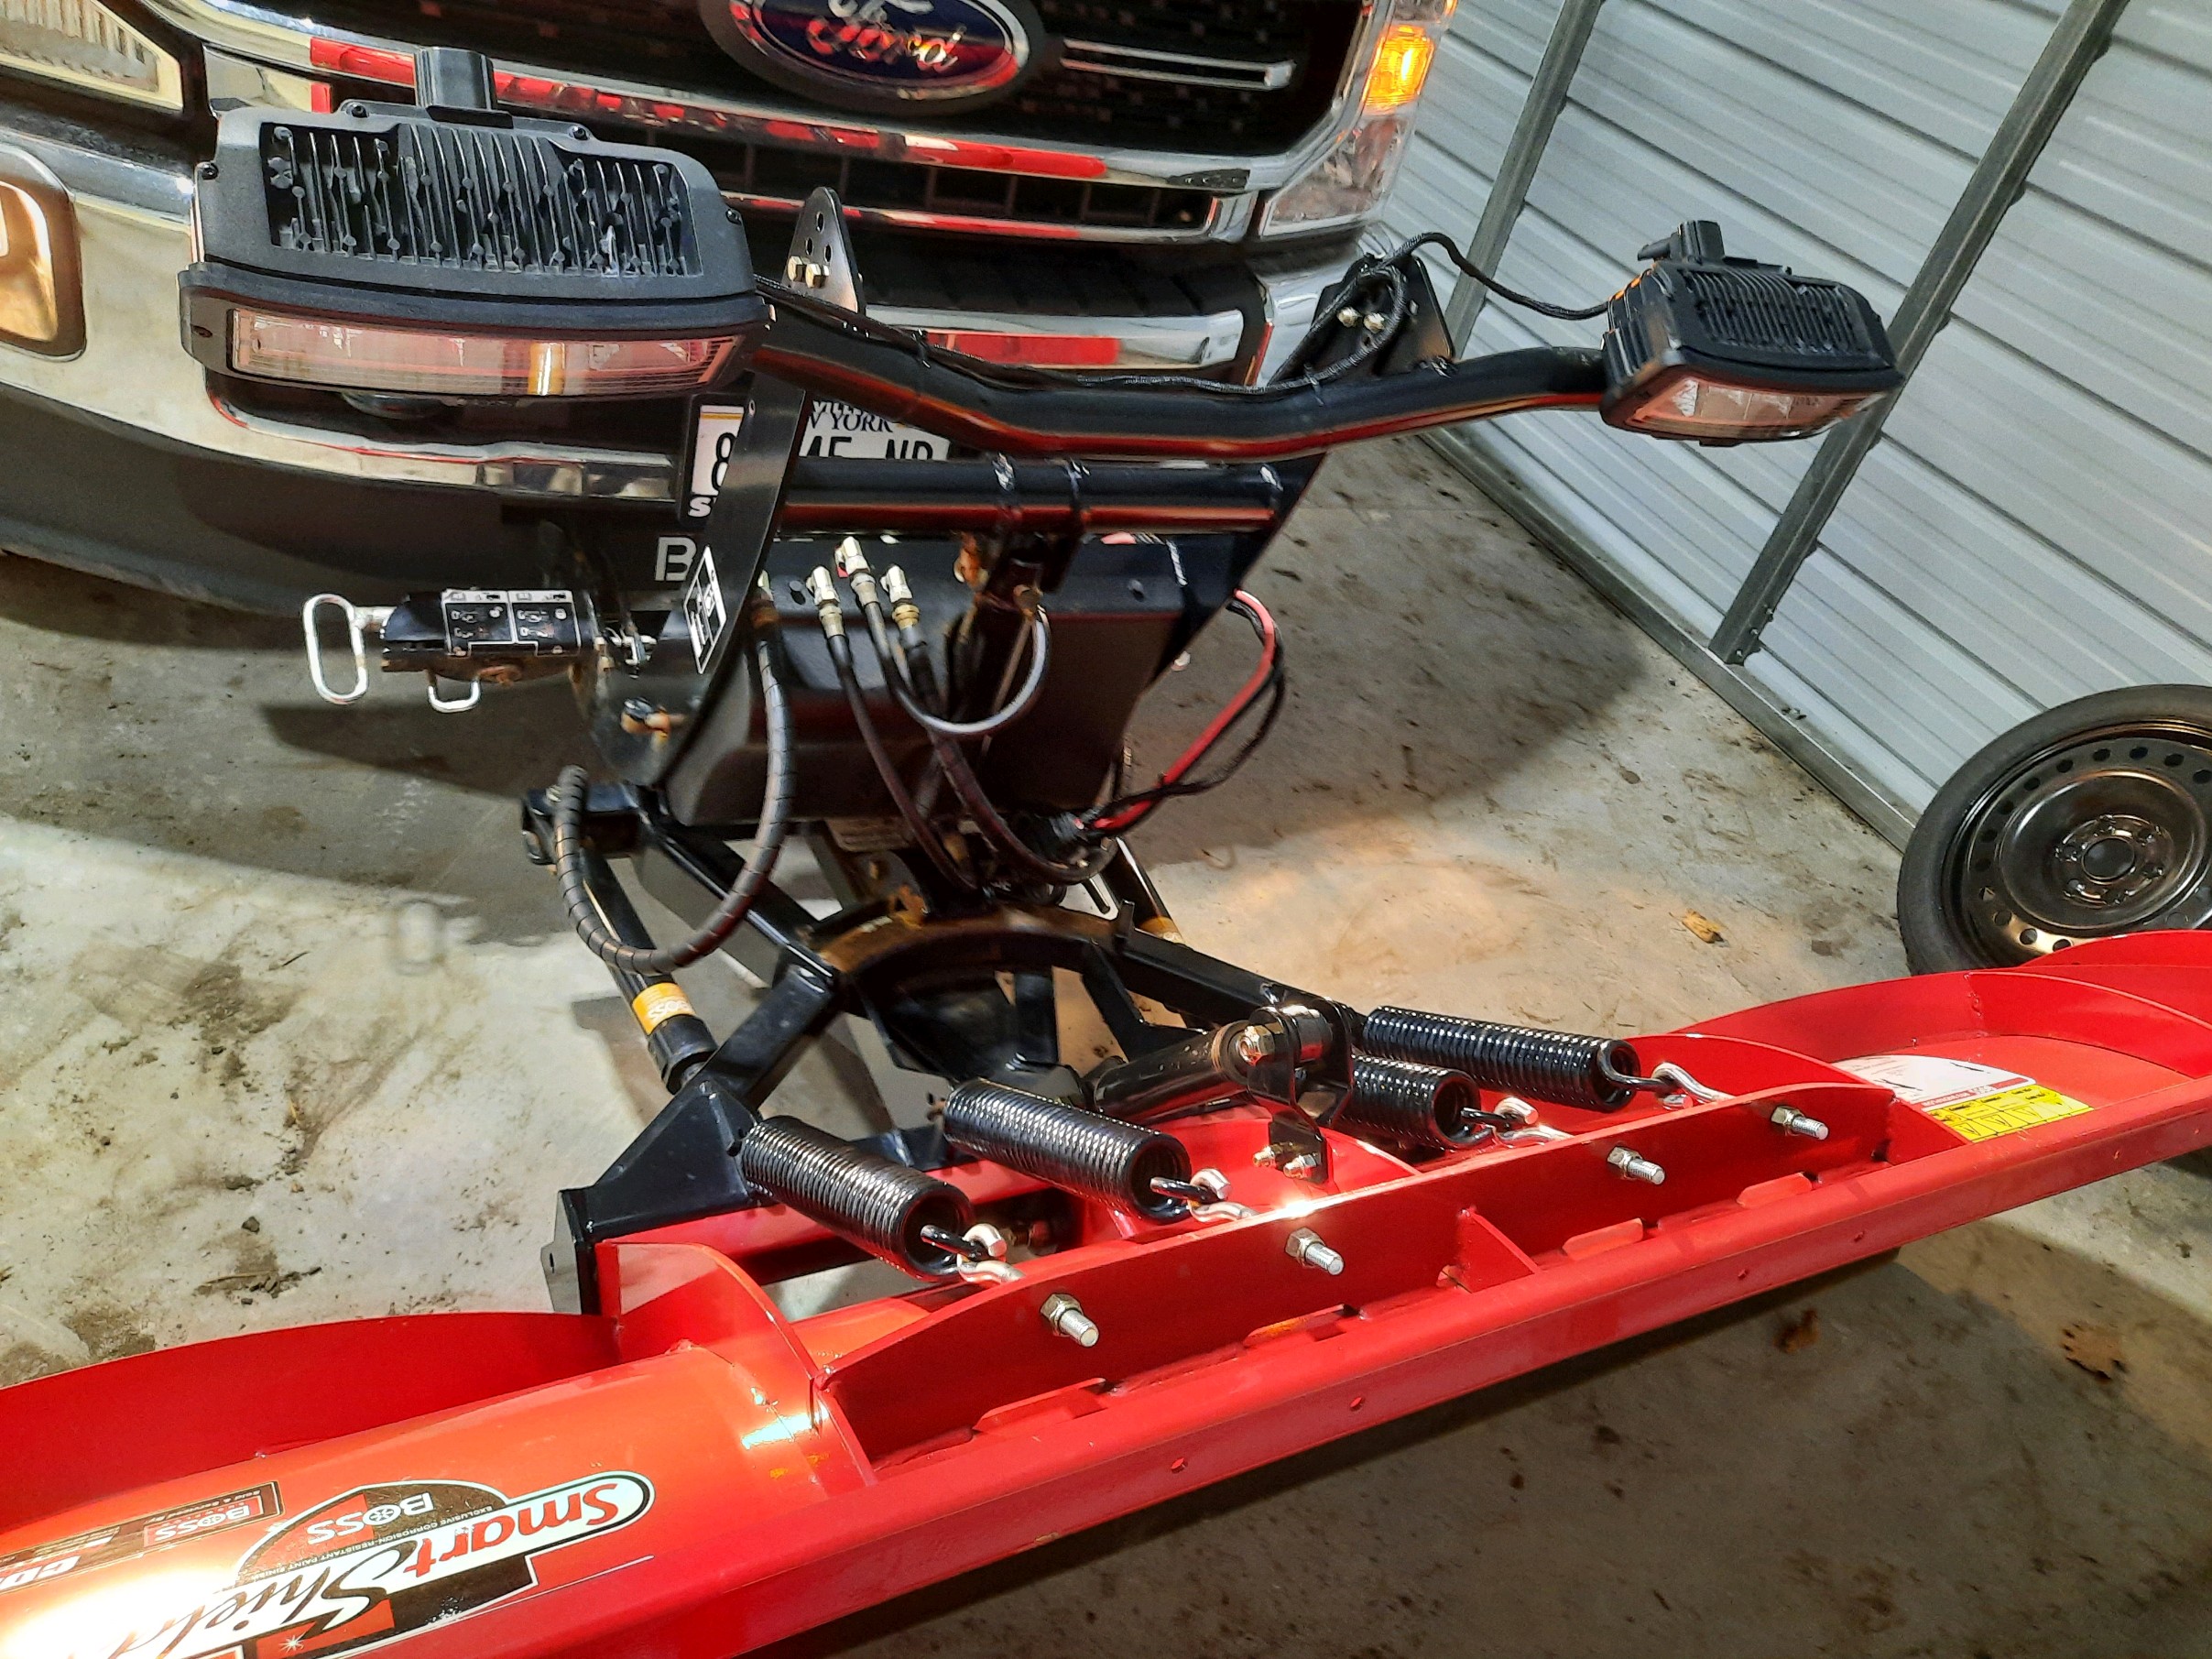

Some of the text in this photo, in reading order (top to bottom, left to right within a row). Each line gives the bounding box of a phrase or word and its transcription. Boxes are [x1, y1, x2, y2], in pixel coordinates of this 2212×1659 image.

[154, 1504, 250, 1542] BOSS
[307, 1491, 434, 1545] BOSS
[403, 1482, 621, 1577] Smart
[439, 1506, 494, 1528] EXCLUSIVE
[288, 1556, 319, 1572] PAINT
